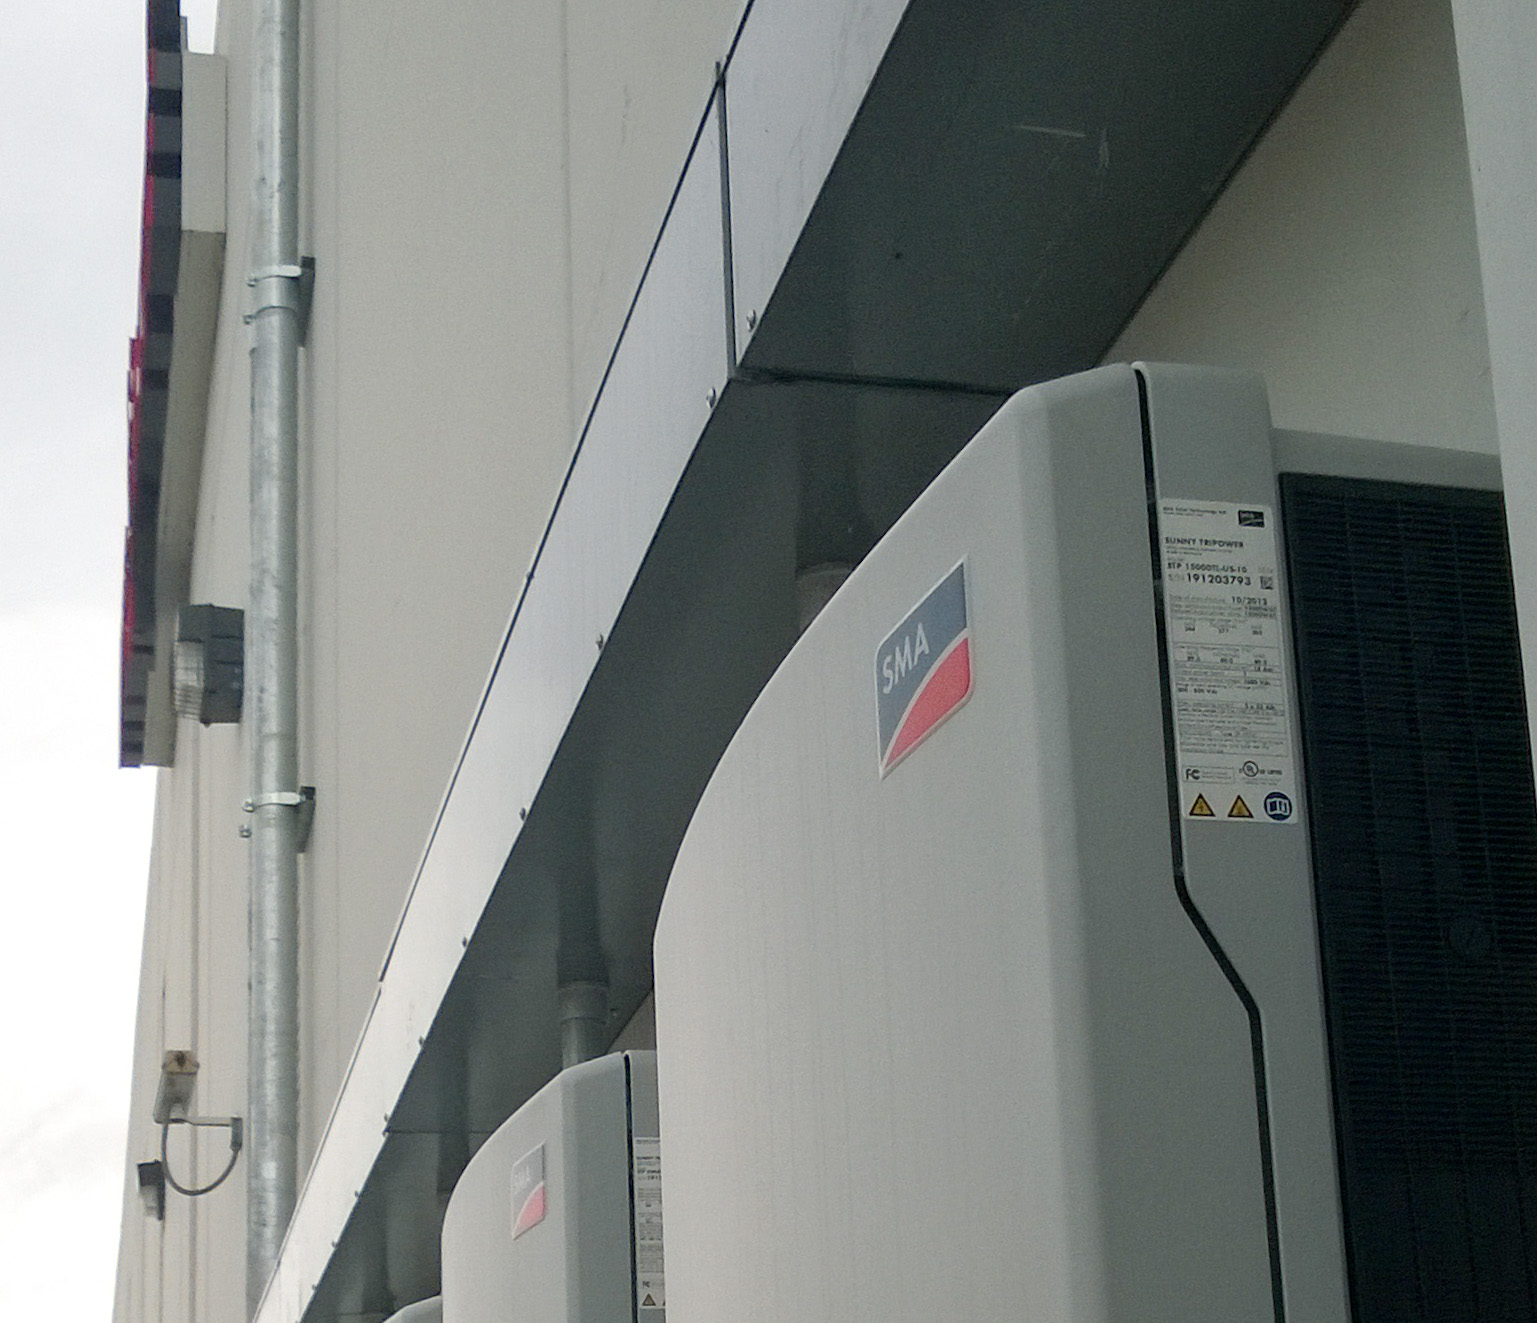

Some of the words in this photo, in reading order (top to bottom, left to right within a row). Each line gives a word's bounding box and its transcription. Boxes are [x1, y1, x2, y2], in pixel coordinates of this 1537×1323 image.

[1164, 537, 1195, 546] SUNNY
[1198, 539, 1243, 548] TRIPOWER
[1187, 573, 1252, 586] 191203793
[882, 623, 929, 694] SMA
